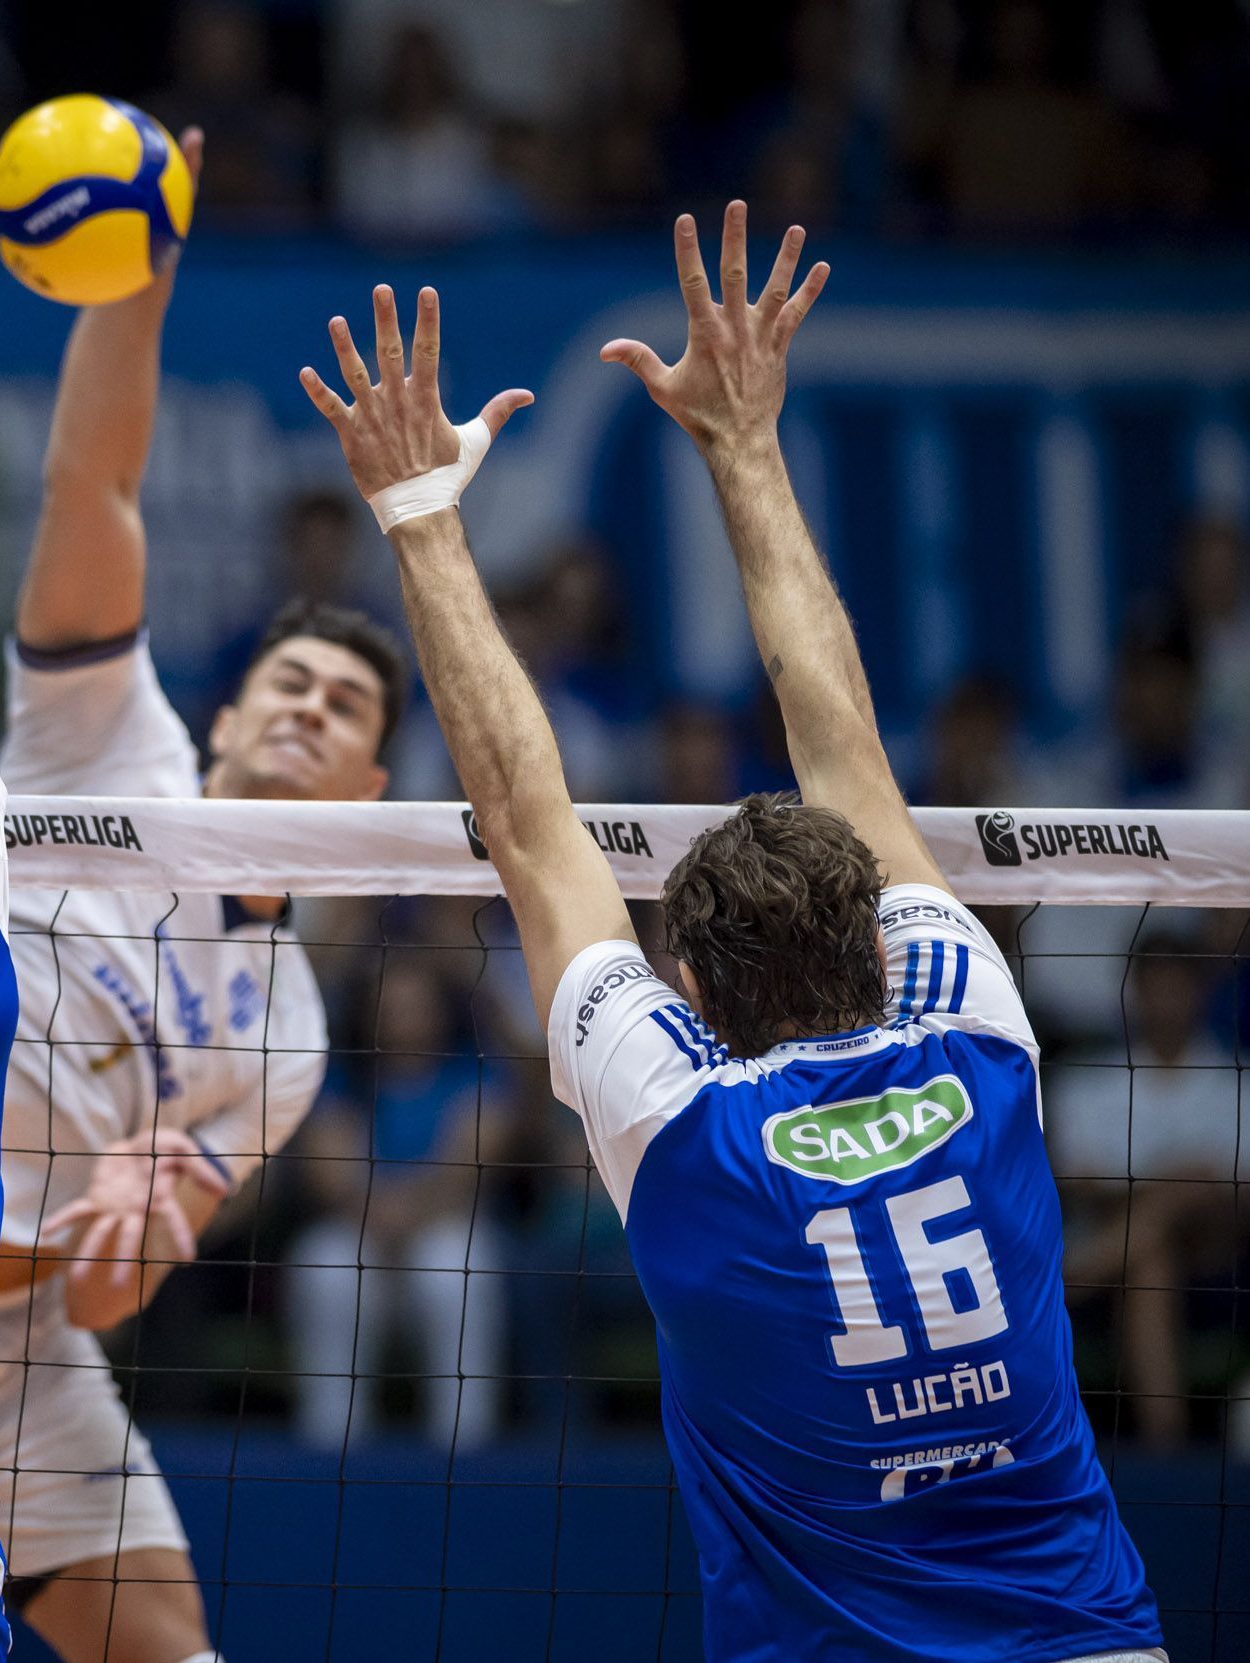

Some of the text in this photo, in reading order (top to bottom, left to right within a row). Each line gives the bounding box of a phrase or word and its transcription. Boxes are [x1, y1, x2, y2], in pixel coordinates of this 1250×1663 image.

[4, 814, 143, 852] SUPERLIGA
[582, 821, 654, 858] LIGA
[1020, 824, 1170, 862] SUPERLIGA
[816, 1036, 870, 1052] CRUZEIRO
[789, 1099, 954, 1163] SADA
[804, 1174, 1009, 1367] 16
[865, 1360, 1011, 1425] LUCÃO
